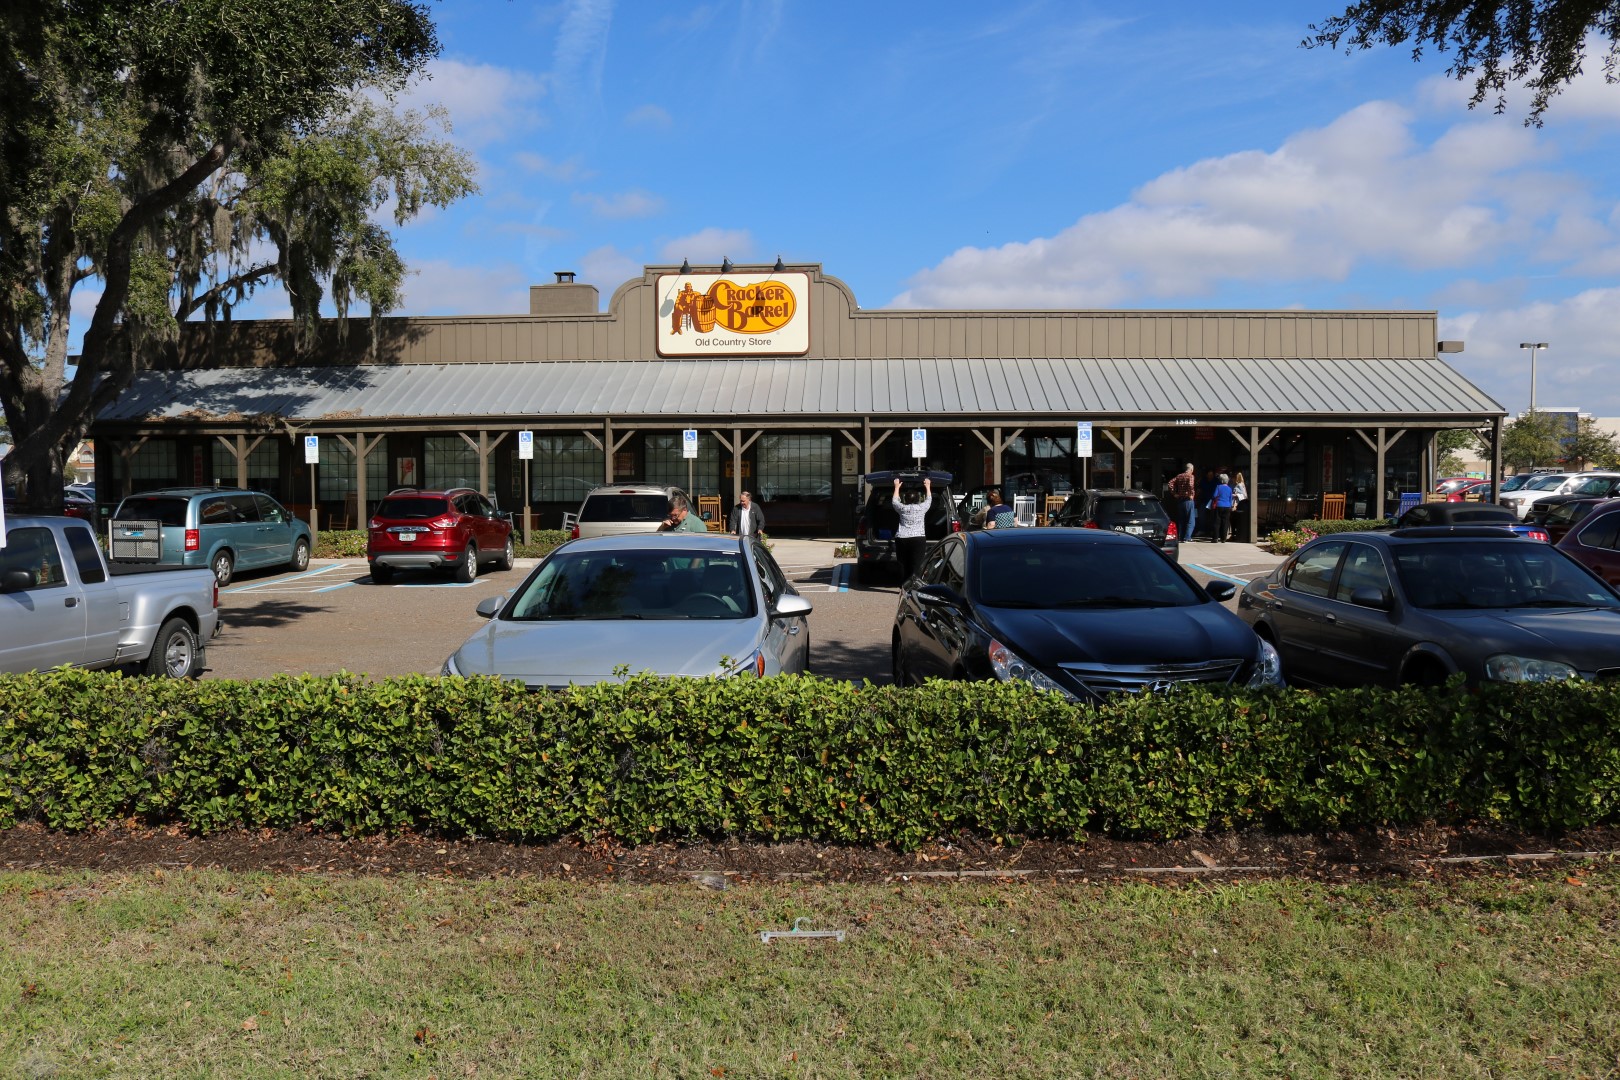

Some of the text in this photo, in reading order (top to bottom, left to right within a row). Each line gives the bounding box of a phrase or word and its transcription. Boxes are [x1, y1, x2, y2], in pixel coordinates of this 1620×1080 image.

[709, 281, 785, 310] Cracker
[727, 301, 789, 330] Barrel
[695, 337, 772, 348] Old Country Store
